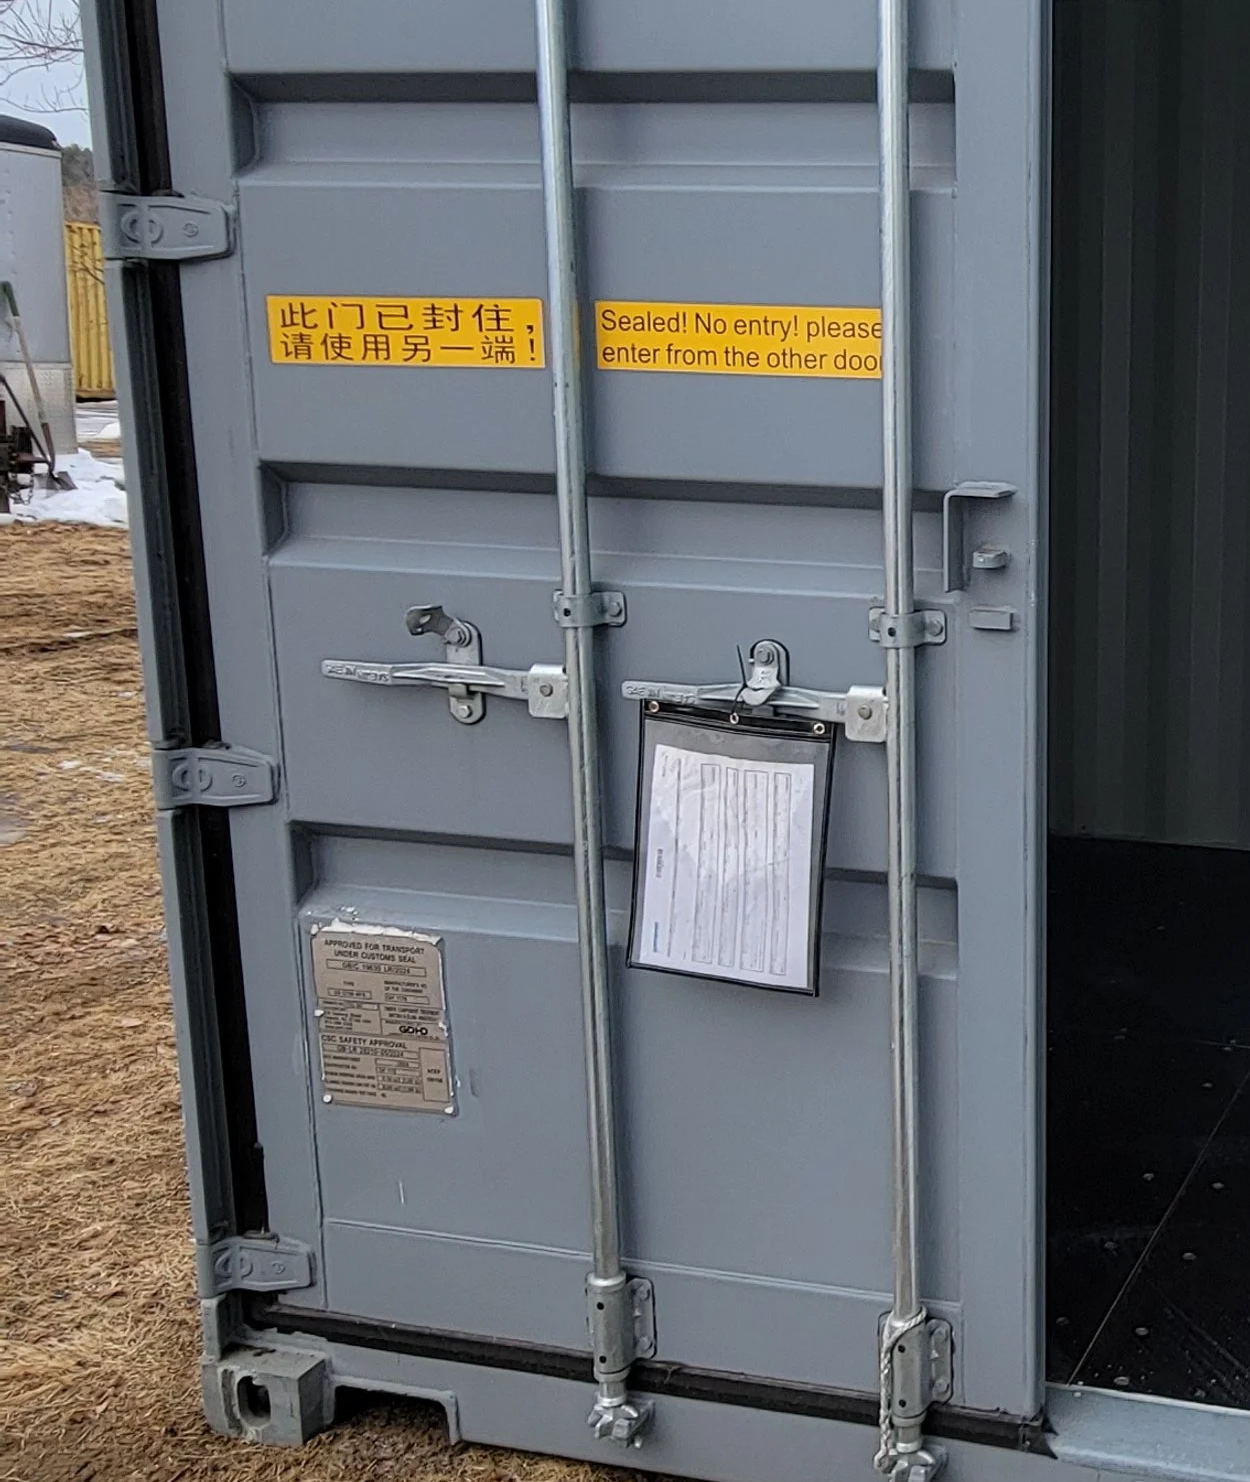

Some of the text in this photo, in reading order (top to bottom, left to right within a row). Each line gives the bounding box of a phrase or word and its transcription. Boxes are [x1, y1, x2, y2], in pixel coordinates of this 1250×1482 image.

[601, 309, 882, 343] Sealed! No entry! please
[602, 343, 661, 364] enter
[666, 343, 717, 366] from
[724, 345, 760, 368] the
[767, 348, 828, 370] other
[324, 939, 425, 955] APPROVED FOR TRANSPORT
[333, 949, 416, 964] UNDER CUSTOMS SEAL
[321, 1034, 408, 1049] CSC SAFETY APPROVAL
